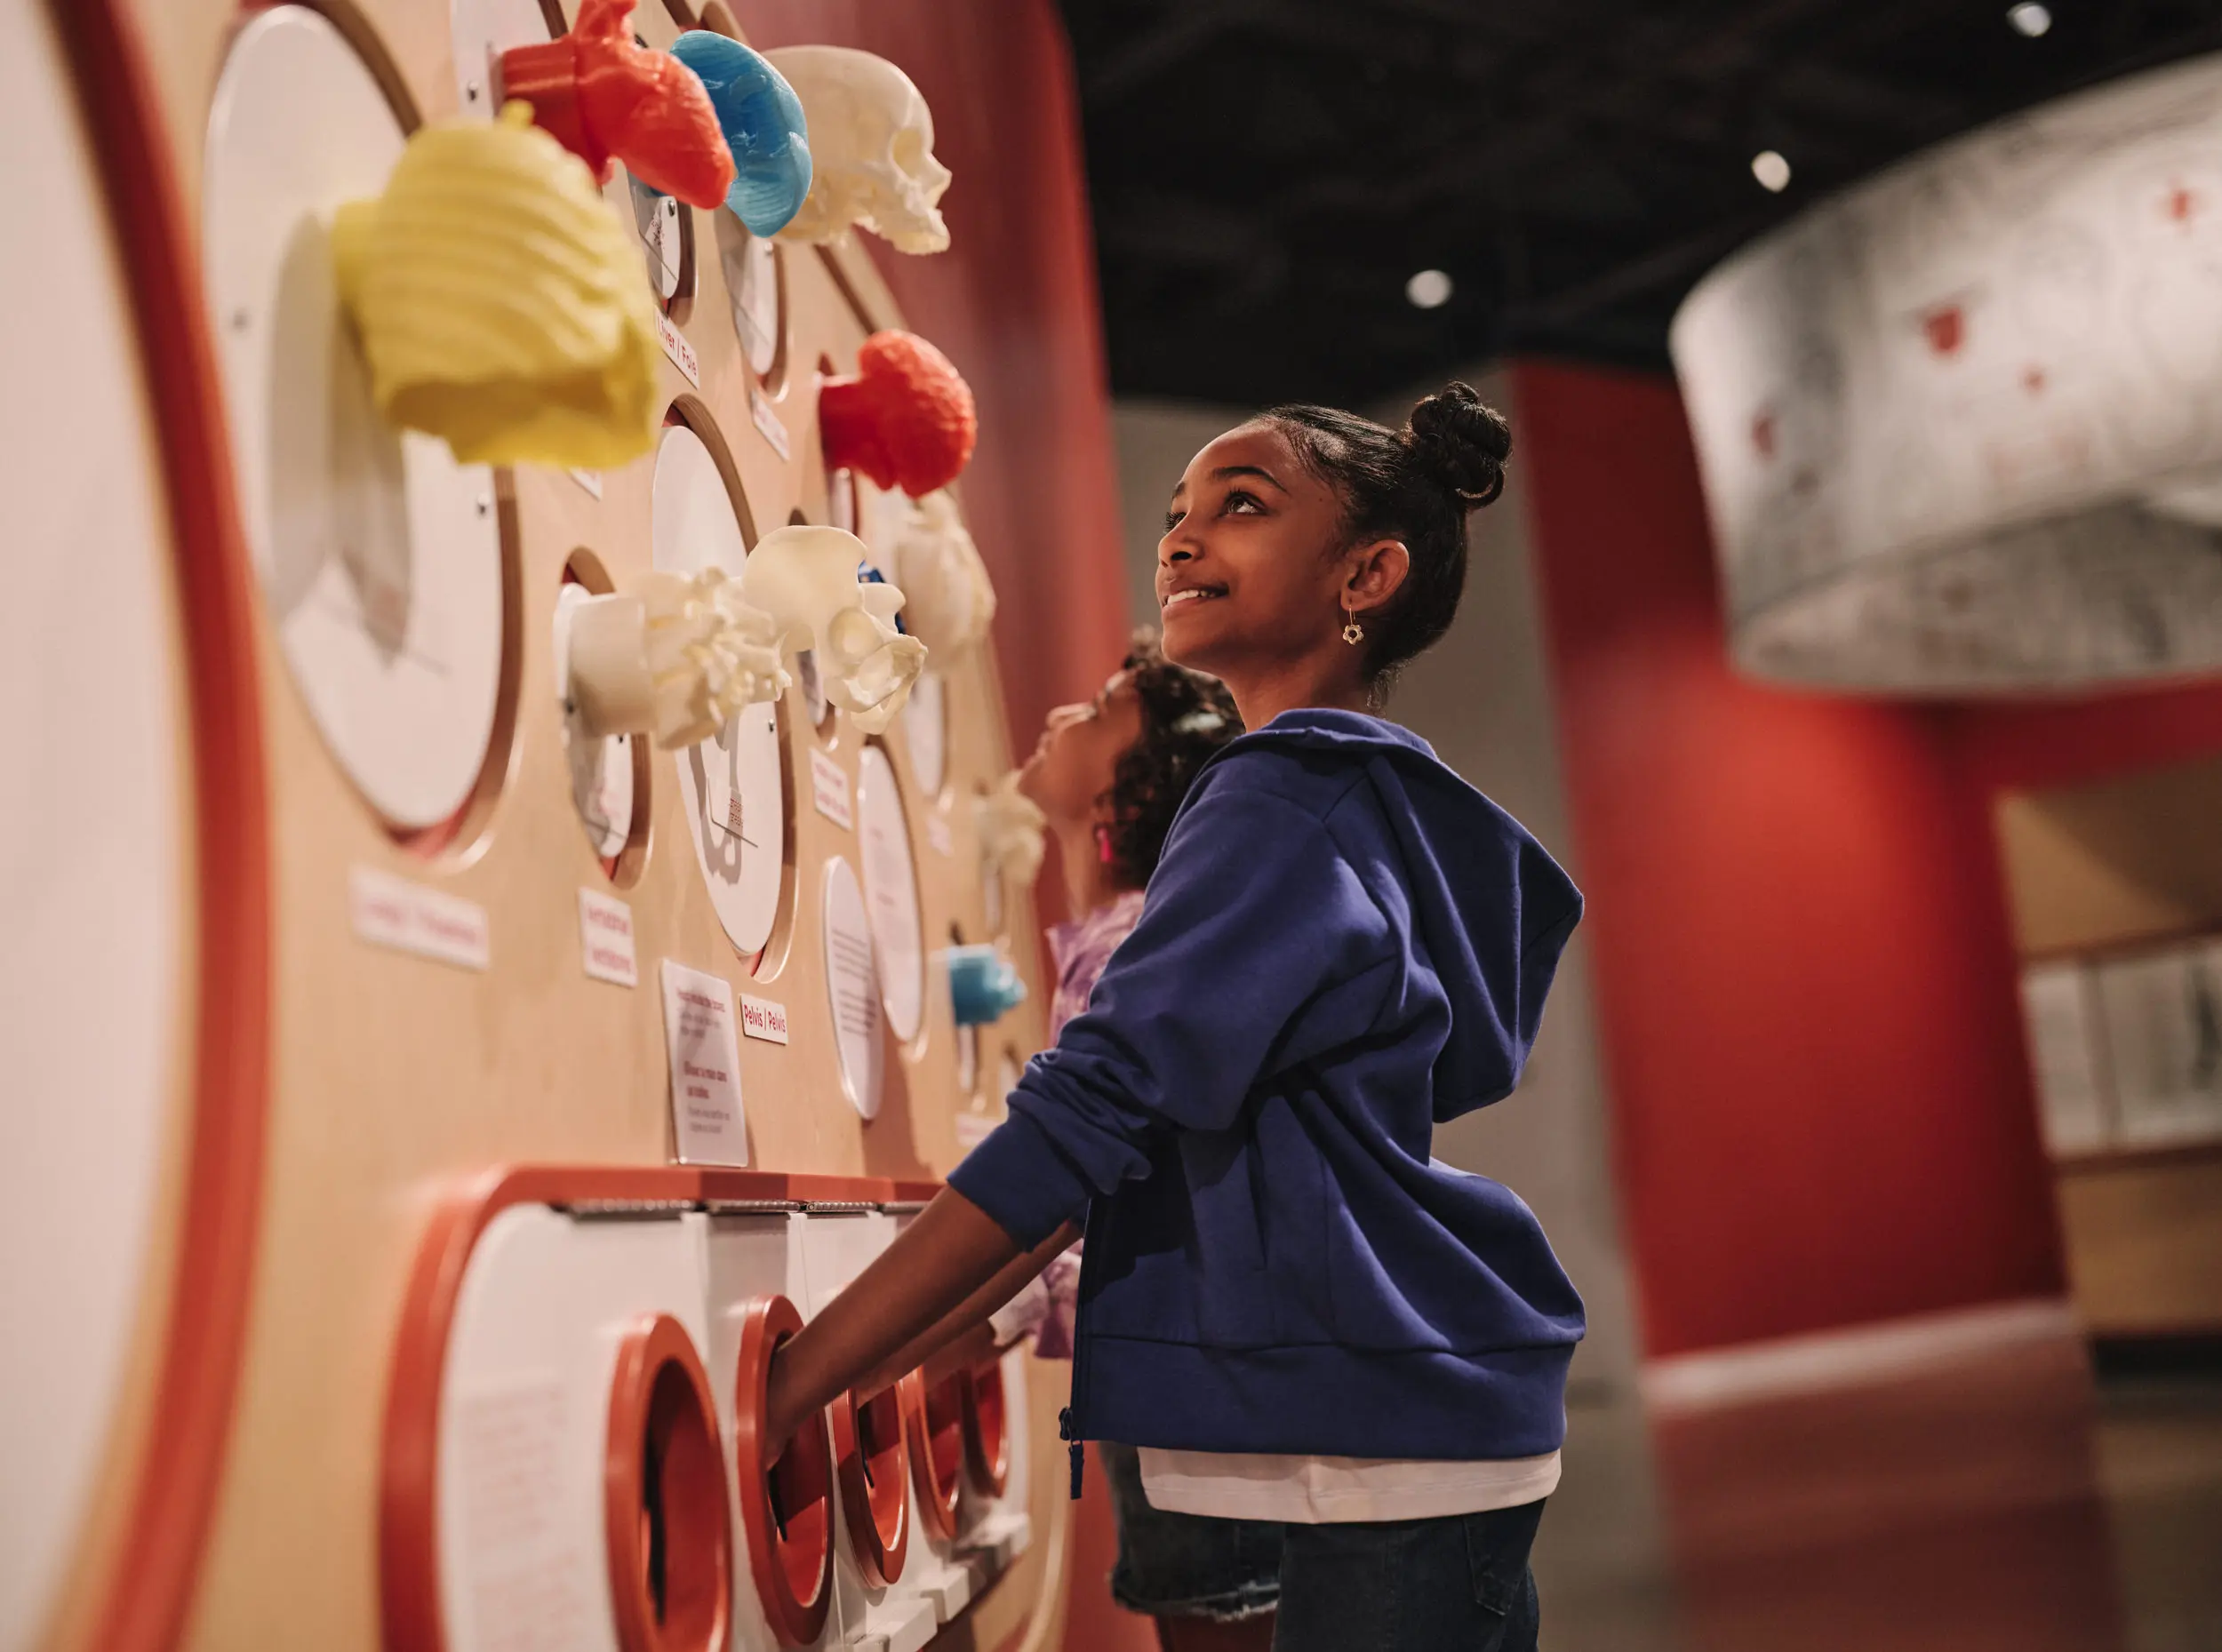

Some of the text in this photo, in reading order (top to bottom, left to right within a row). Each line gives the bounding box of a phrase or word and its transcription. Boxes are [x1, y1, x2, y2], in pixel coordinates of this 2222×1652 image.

[658, 316, 675, 351] Liver
[744, 1004, 763, 1027] Pelvis
[768, 1010, 786, 1033] Pelvis
